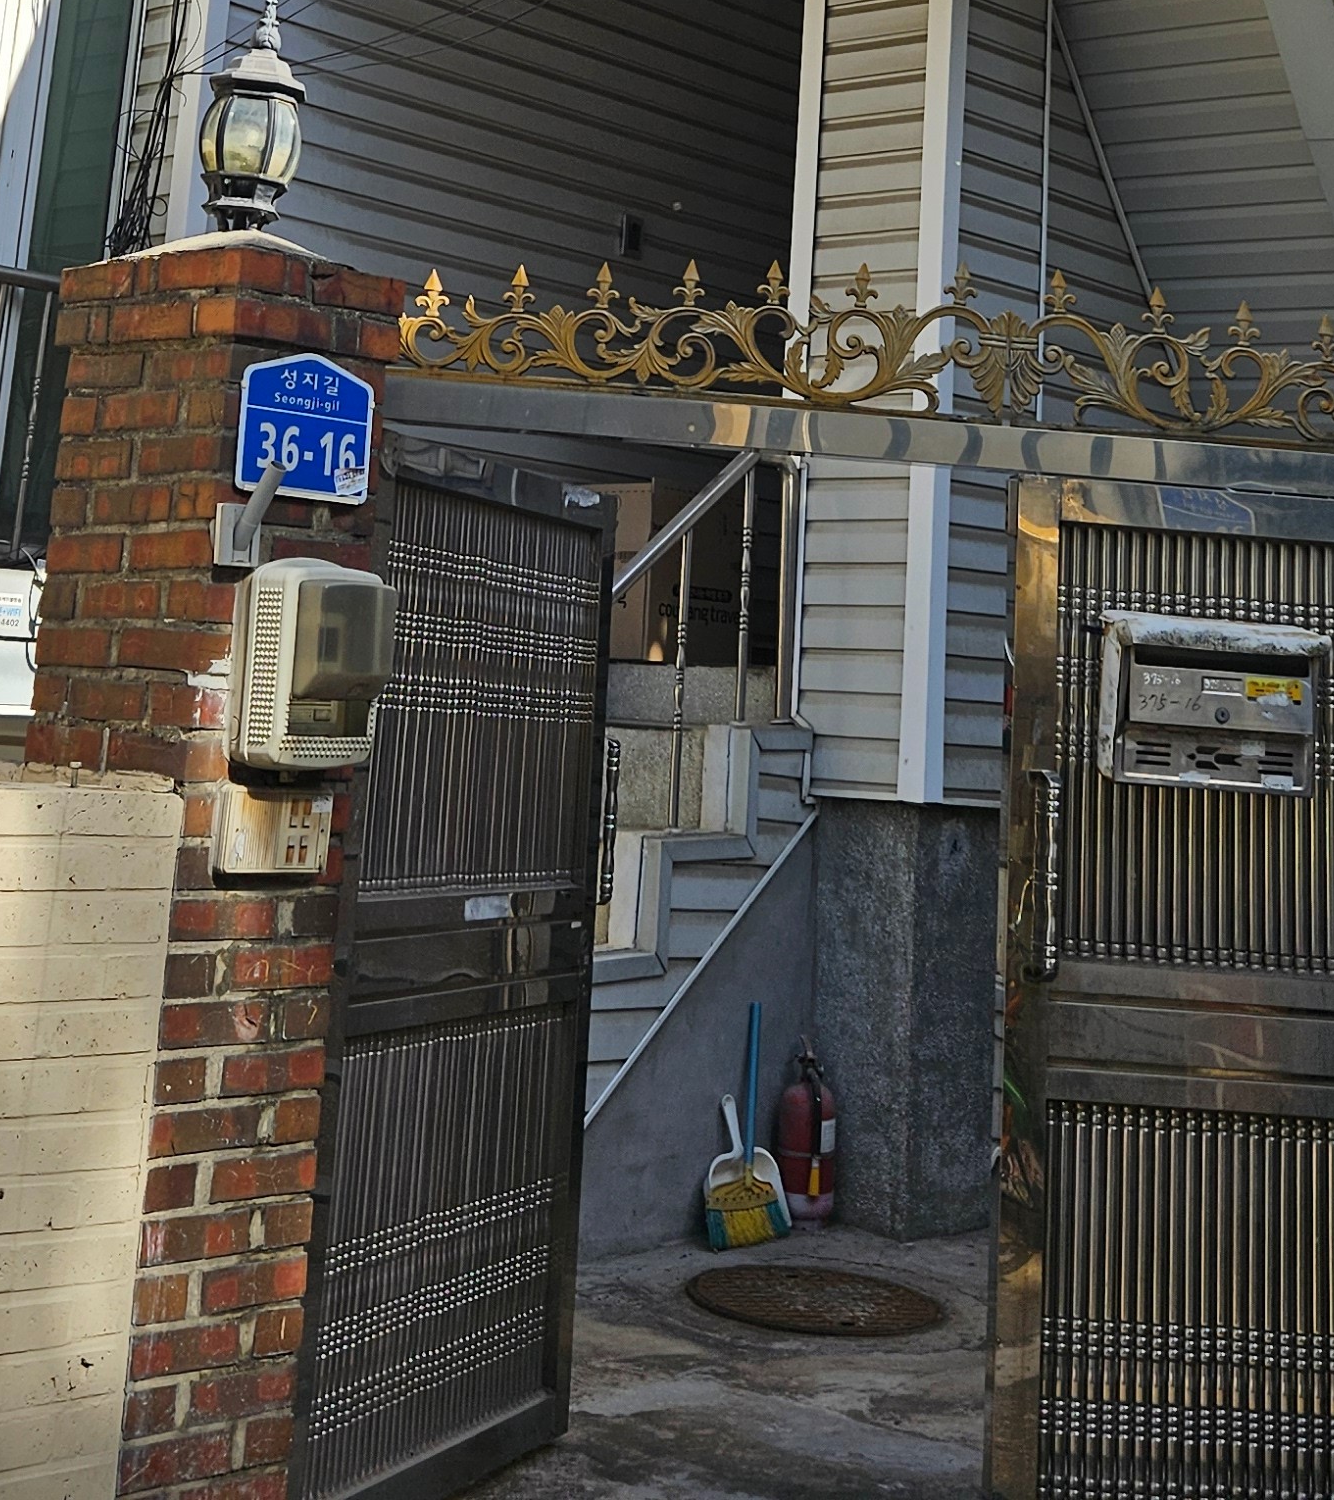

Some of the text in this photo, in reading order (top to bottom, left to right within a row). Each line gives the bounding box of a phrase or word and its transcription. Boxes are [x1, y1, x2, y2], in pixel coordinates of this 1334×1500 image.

[280, 368, 340, 397] 성지길
[274, 392, 340, 413] Seongji-gil
[256, 421, 357, 478] 36-16
[658, 602, 741, 626] couang trave
[1138, 693, 1202, 712] 375-16
